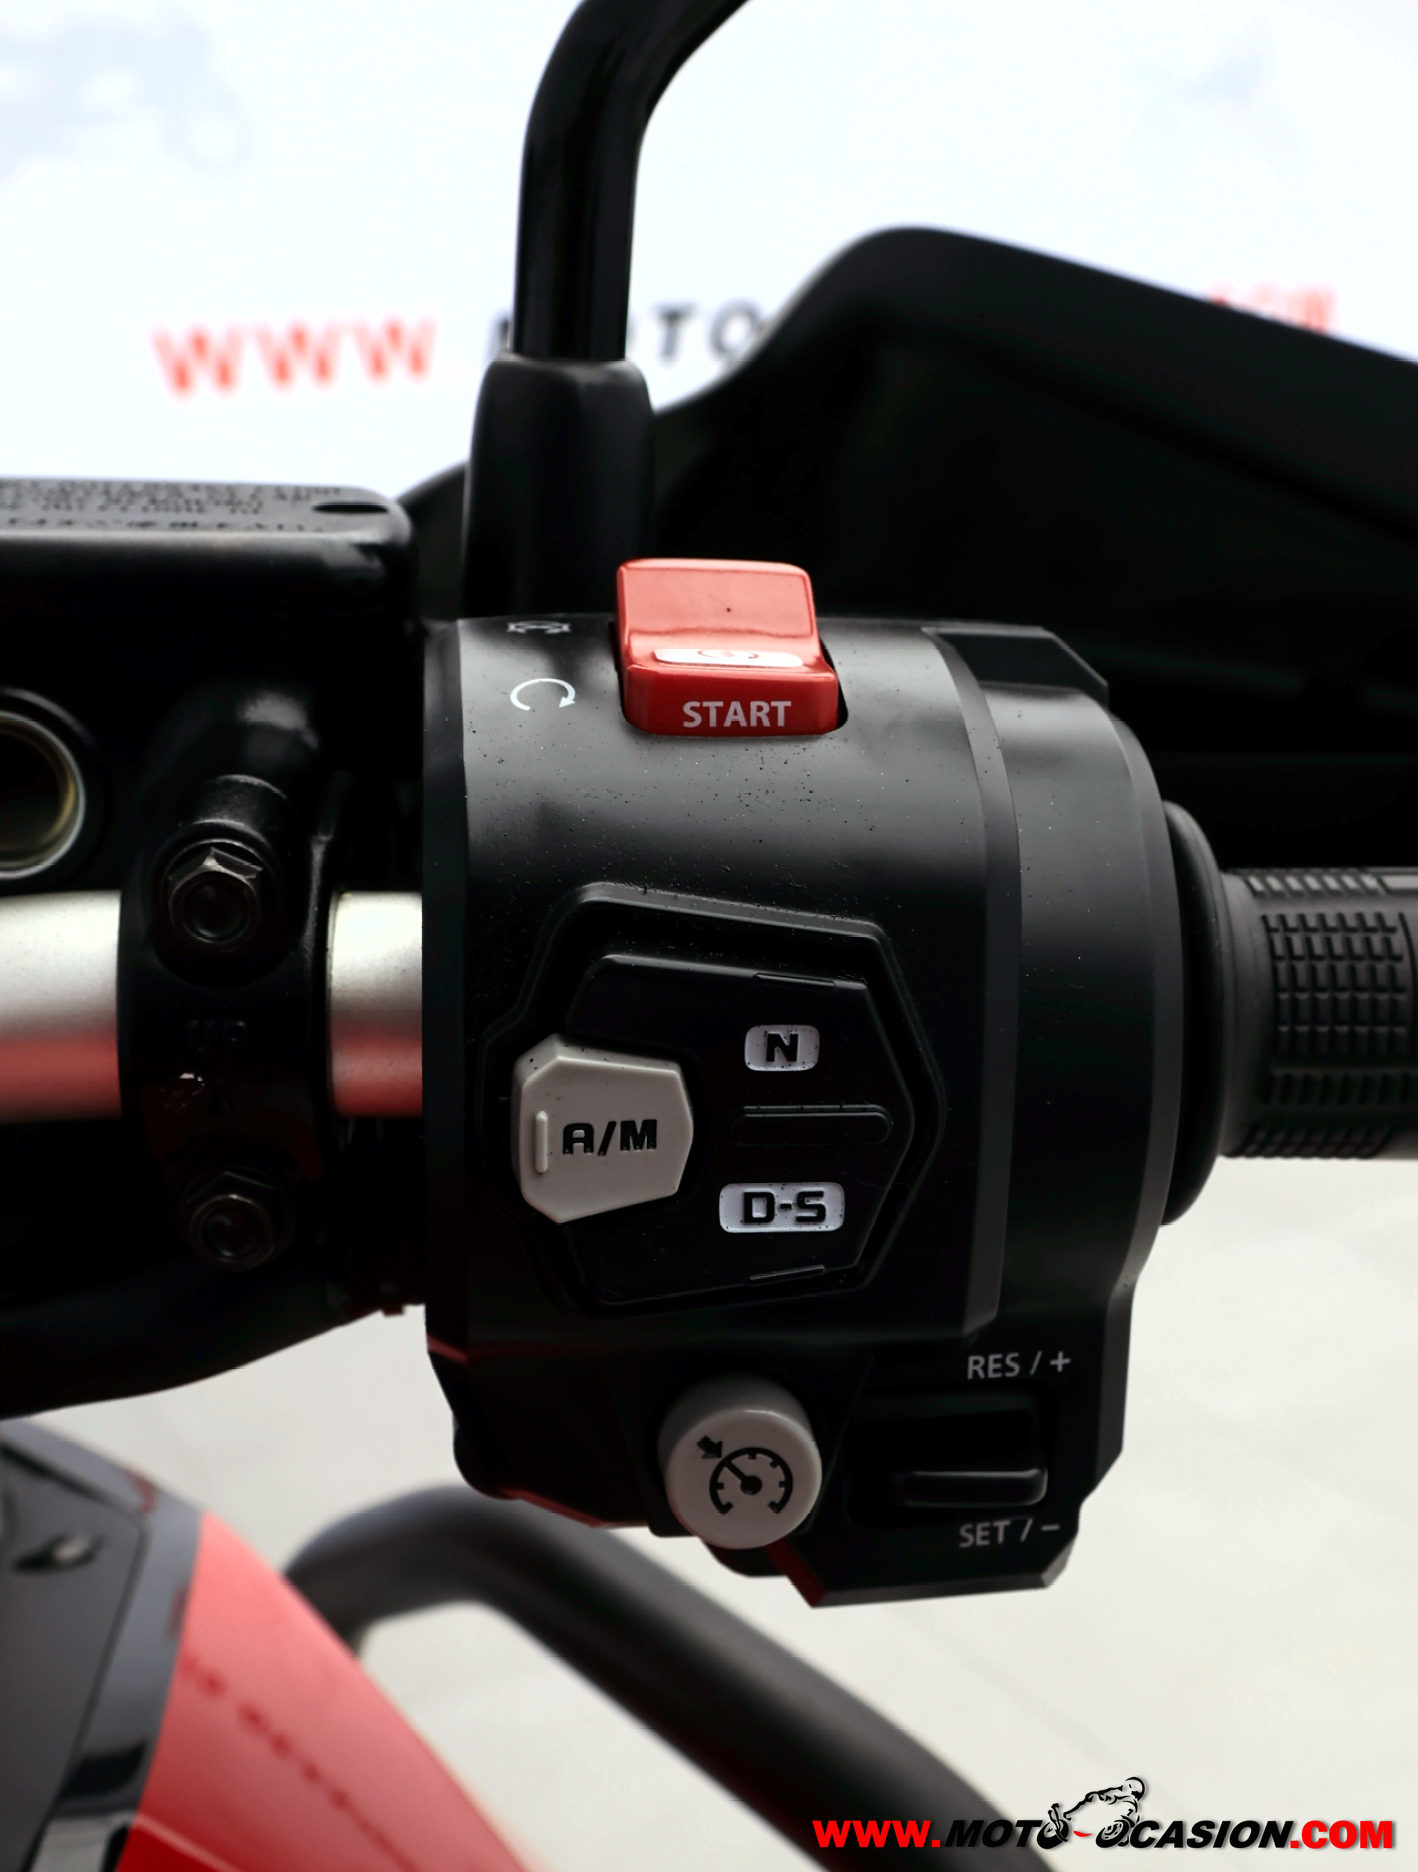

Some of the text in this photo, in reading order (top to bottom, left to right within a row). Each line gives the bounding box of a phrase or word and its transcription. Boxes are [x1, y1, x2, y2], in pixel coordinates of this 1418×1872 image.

[682, 700, 792, 729] START
[764, 1032, 799, 1063] N
[562, 1118, 658, 1157] A/M
[743, 1189, 826, 1224] D-S
